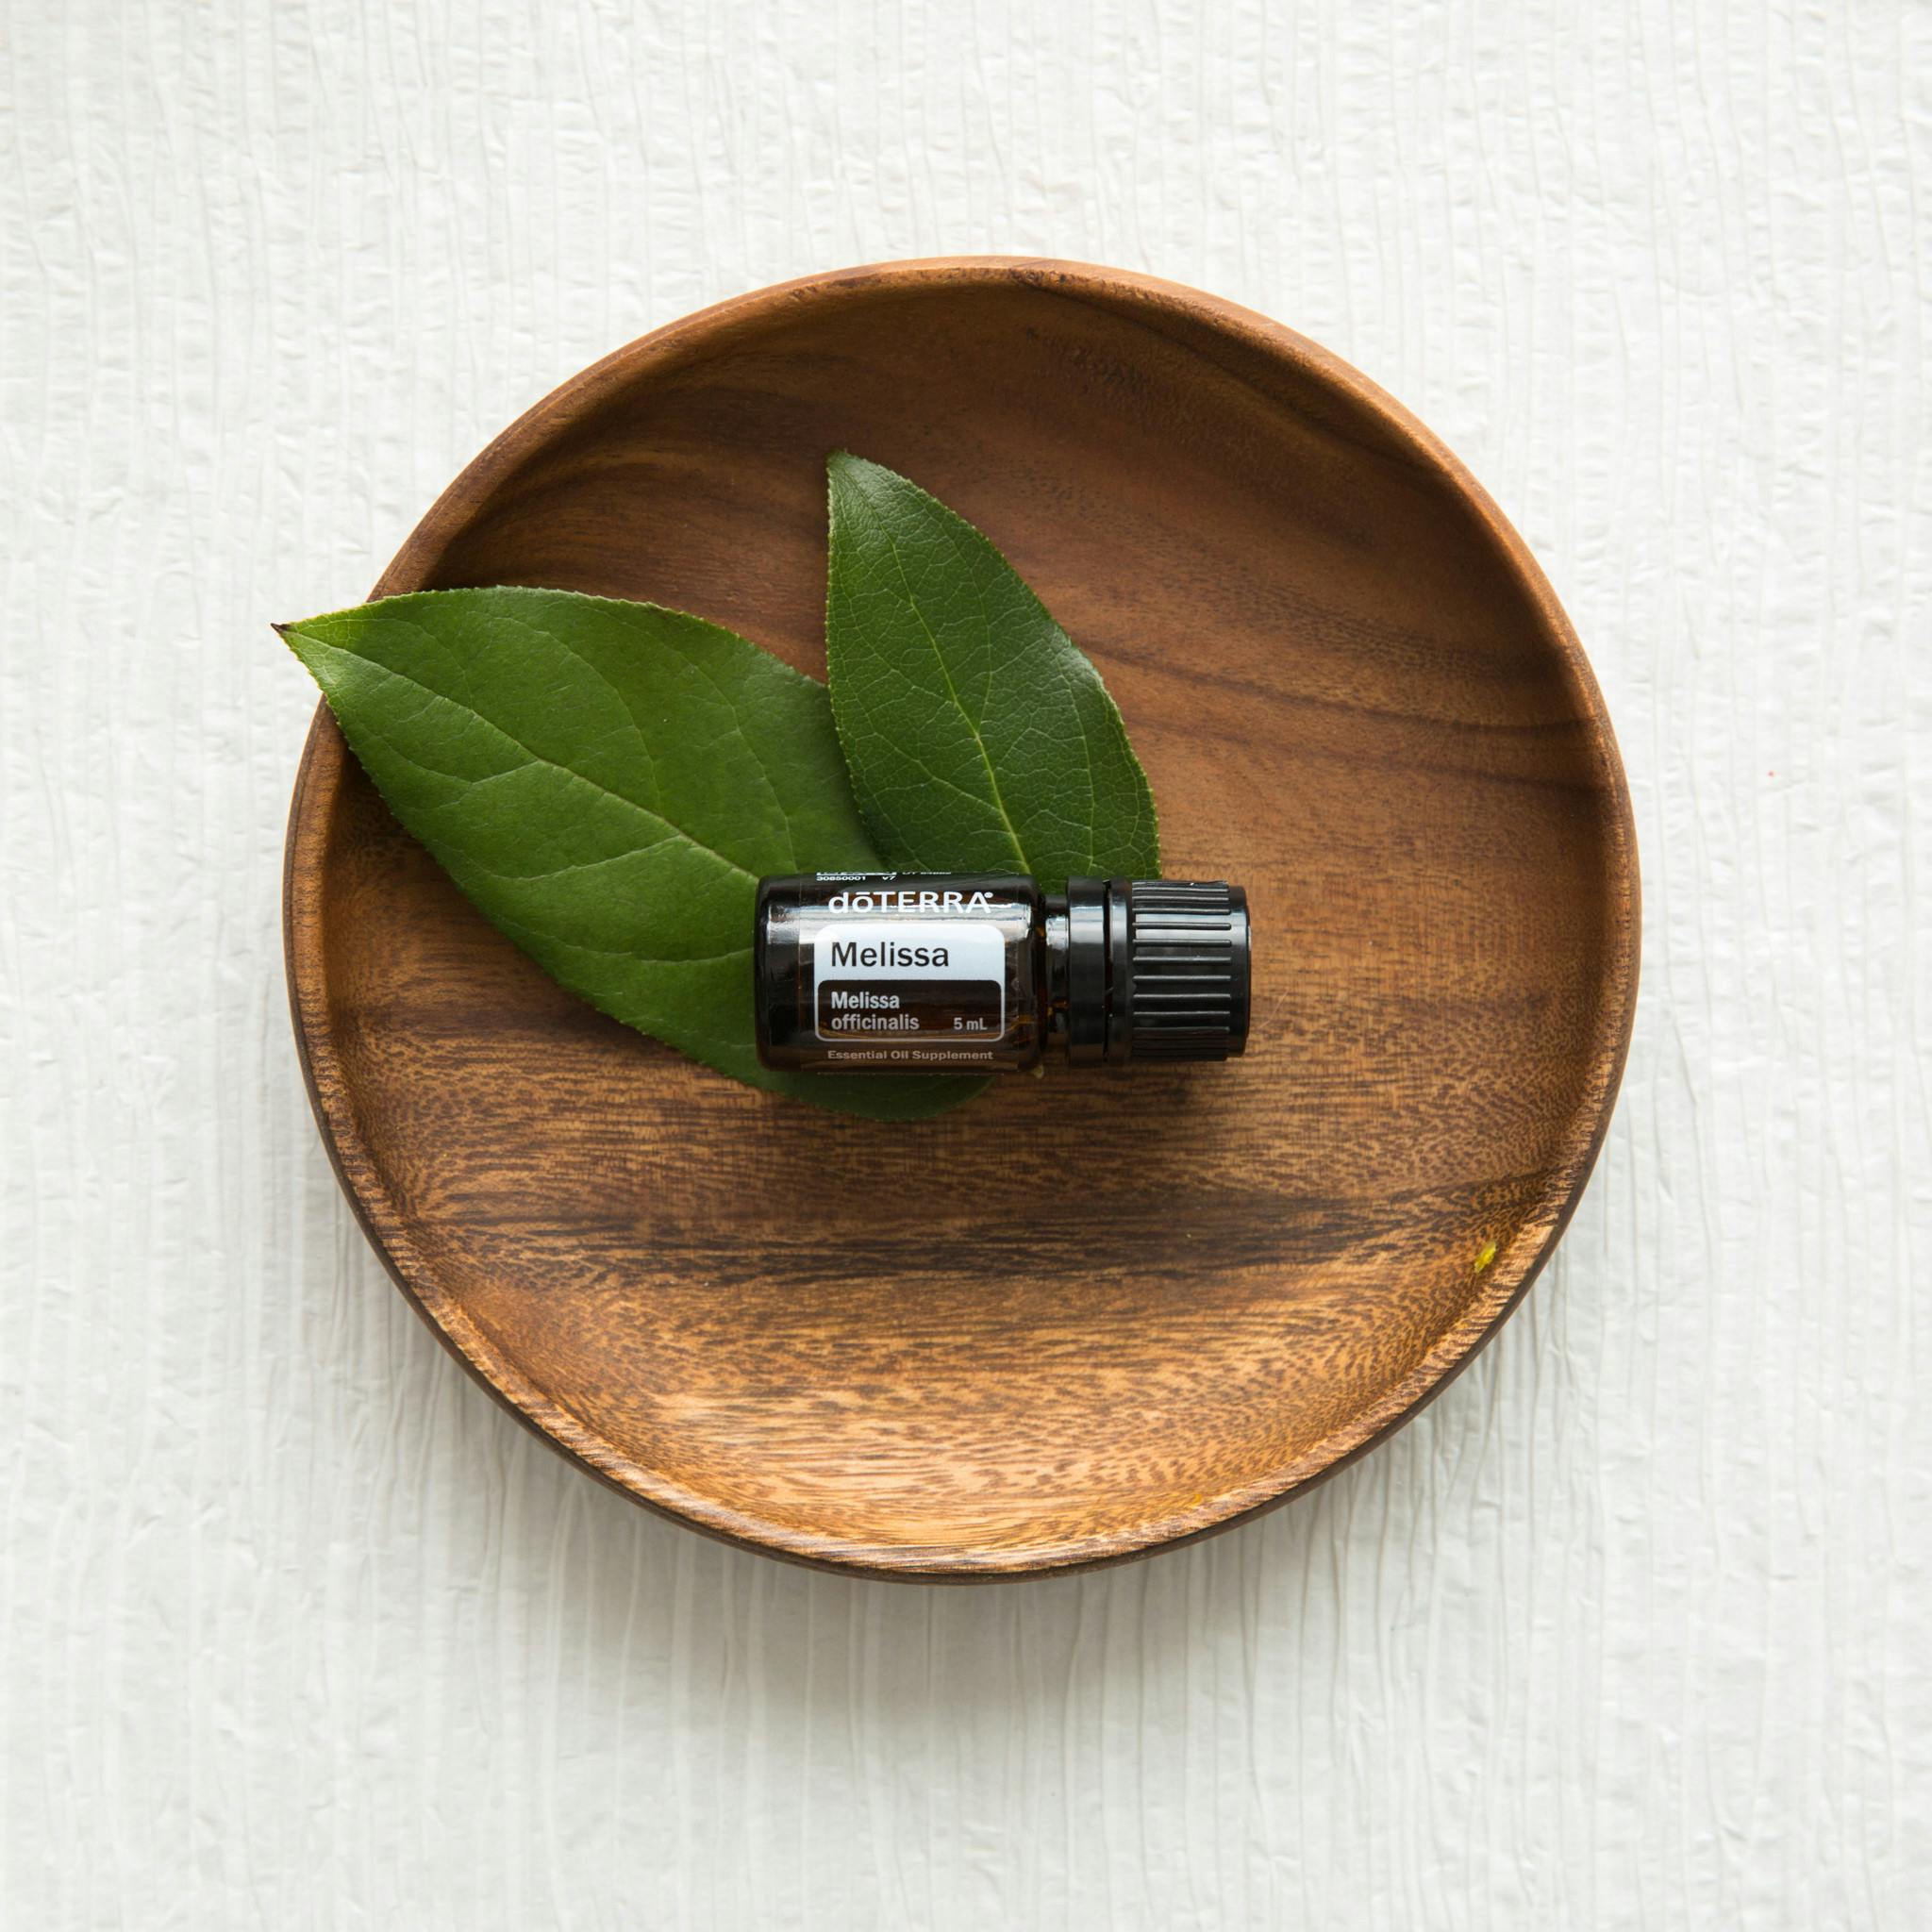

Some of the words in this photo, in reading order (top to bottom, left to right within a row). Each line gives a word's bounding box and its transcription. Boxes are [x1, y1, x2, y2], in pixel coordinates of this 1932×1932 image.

[831, 941, 949, 967] Melissa
[831, 991, 900, 1009] Melissa
[831, 1014, 920, 1030] officinalis
[953, 1018, 962, 1030] 5
[966, 1018, 988, 1030] mL
[827, 1050, 887, 1059] Essential
[891, 1050, 908, 1059] Oil
[912, 1050, 993, 1061] Supplement
